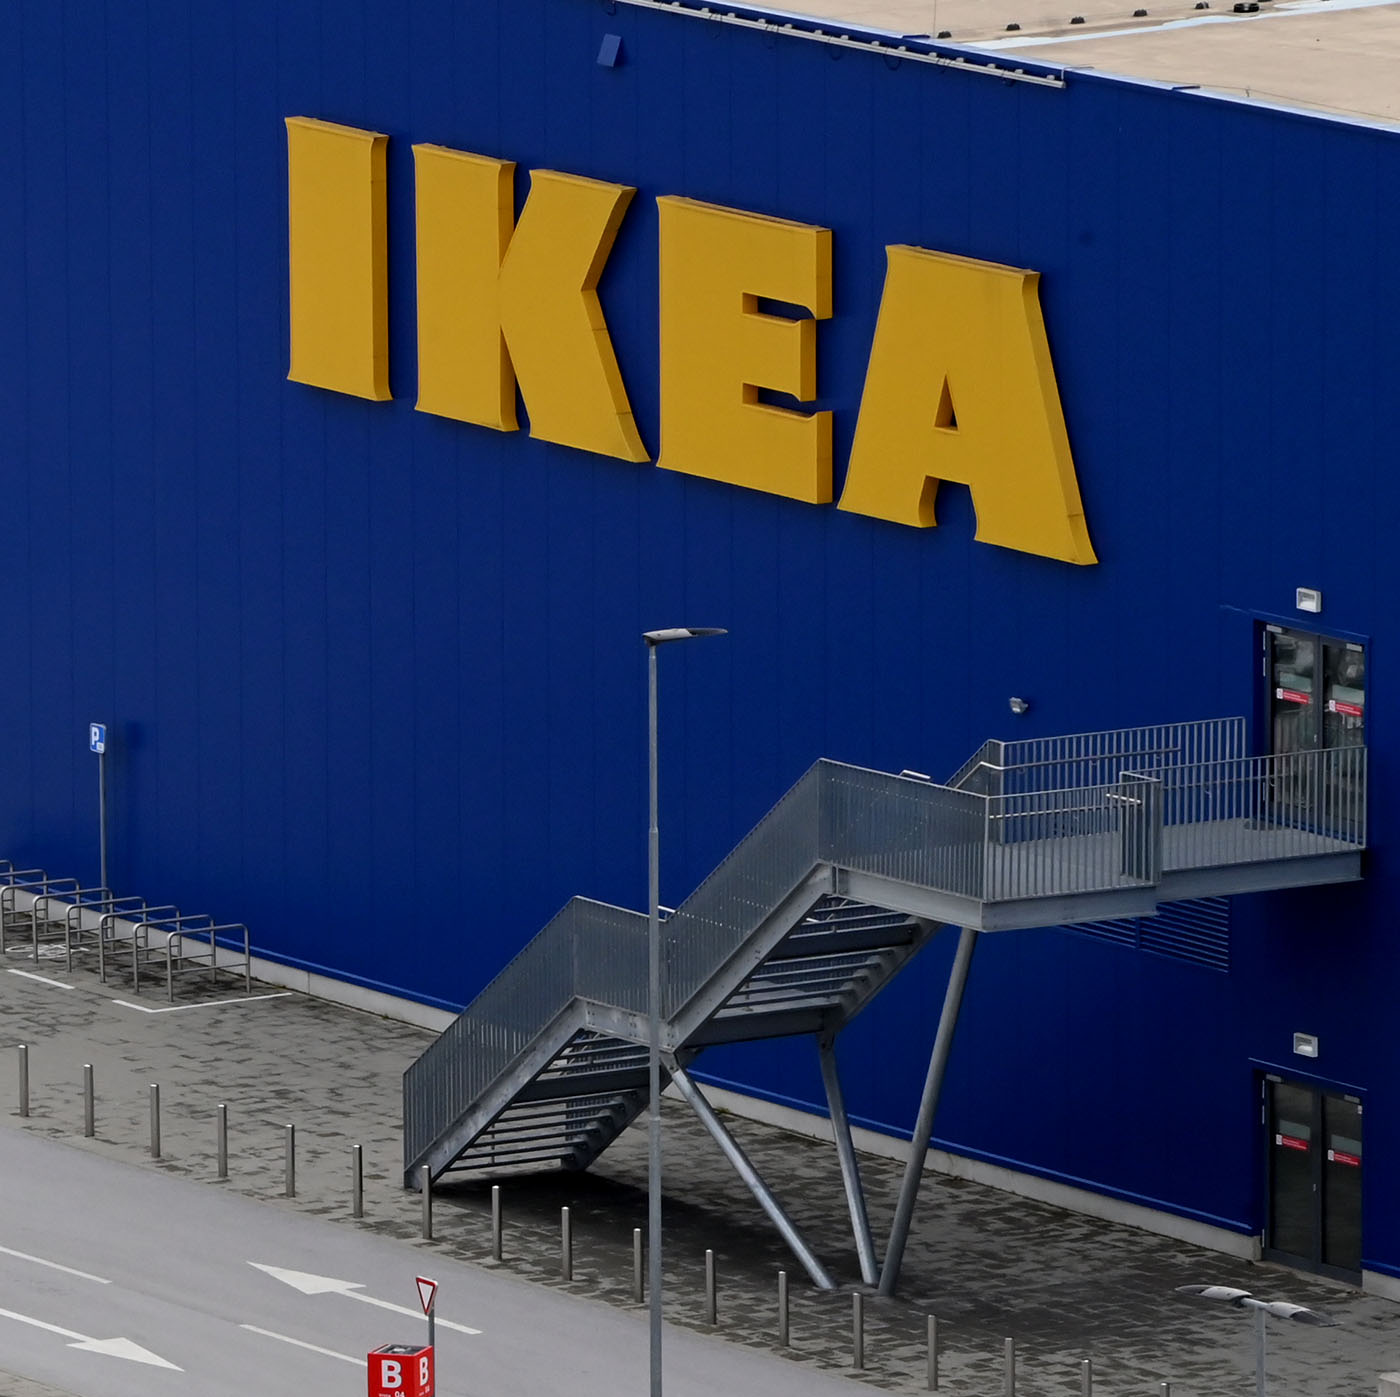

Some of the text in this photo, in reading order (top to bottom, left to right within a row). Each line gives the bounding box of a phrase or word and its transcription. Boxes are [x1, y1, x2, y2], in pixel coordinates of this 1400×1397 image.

[285, 116, 1099, 566] IKEA
[91, 726, 99, 746] P
[381, 1360, 402, 1388] B
[420, 1356, 428, 1387] B
